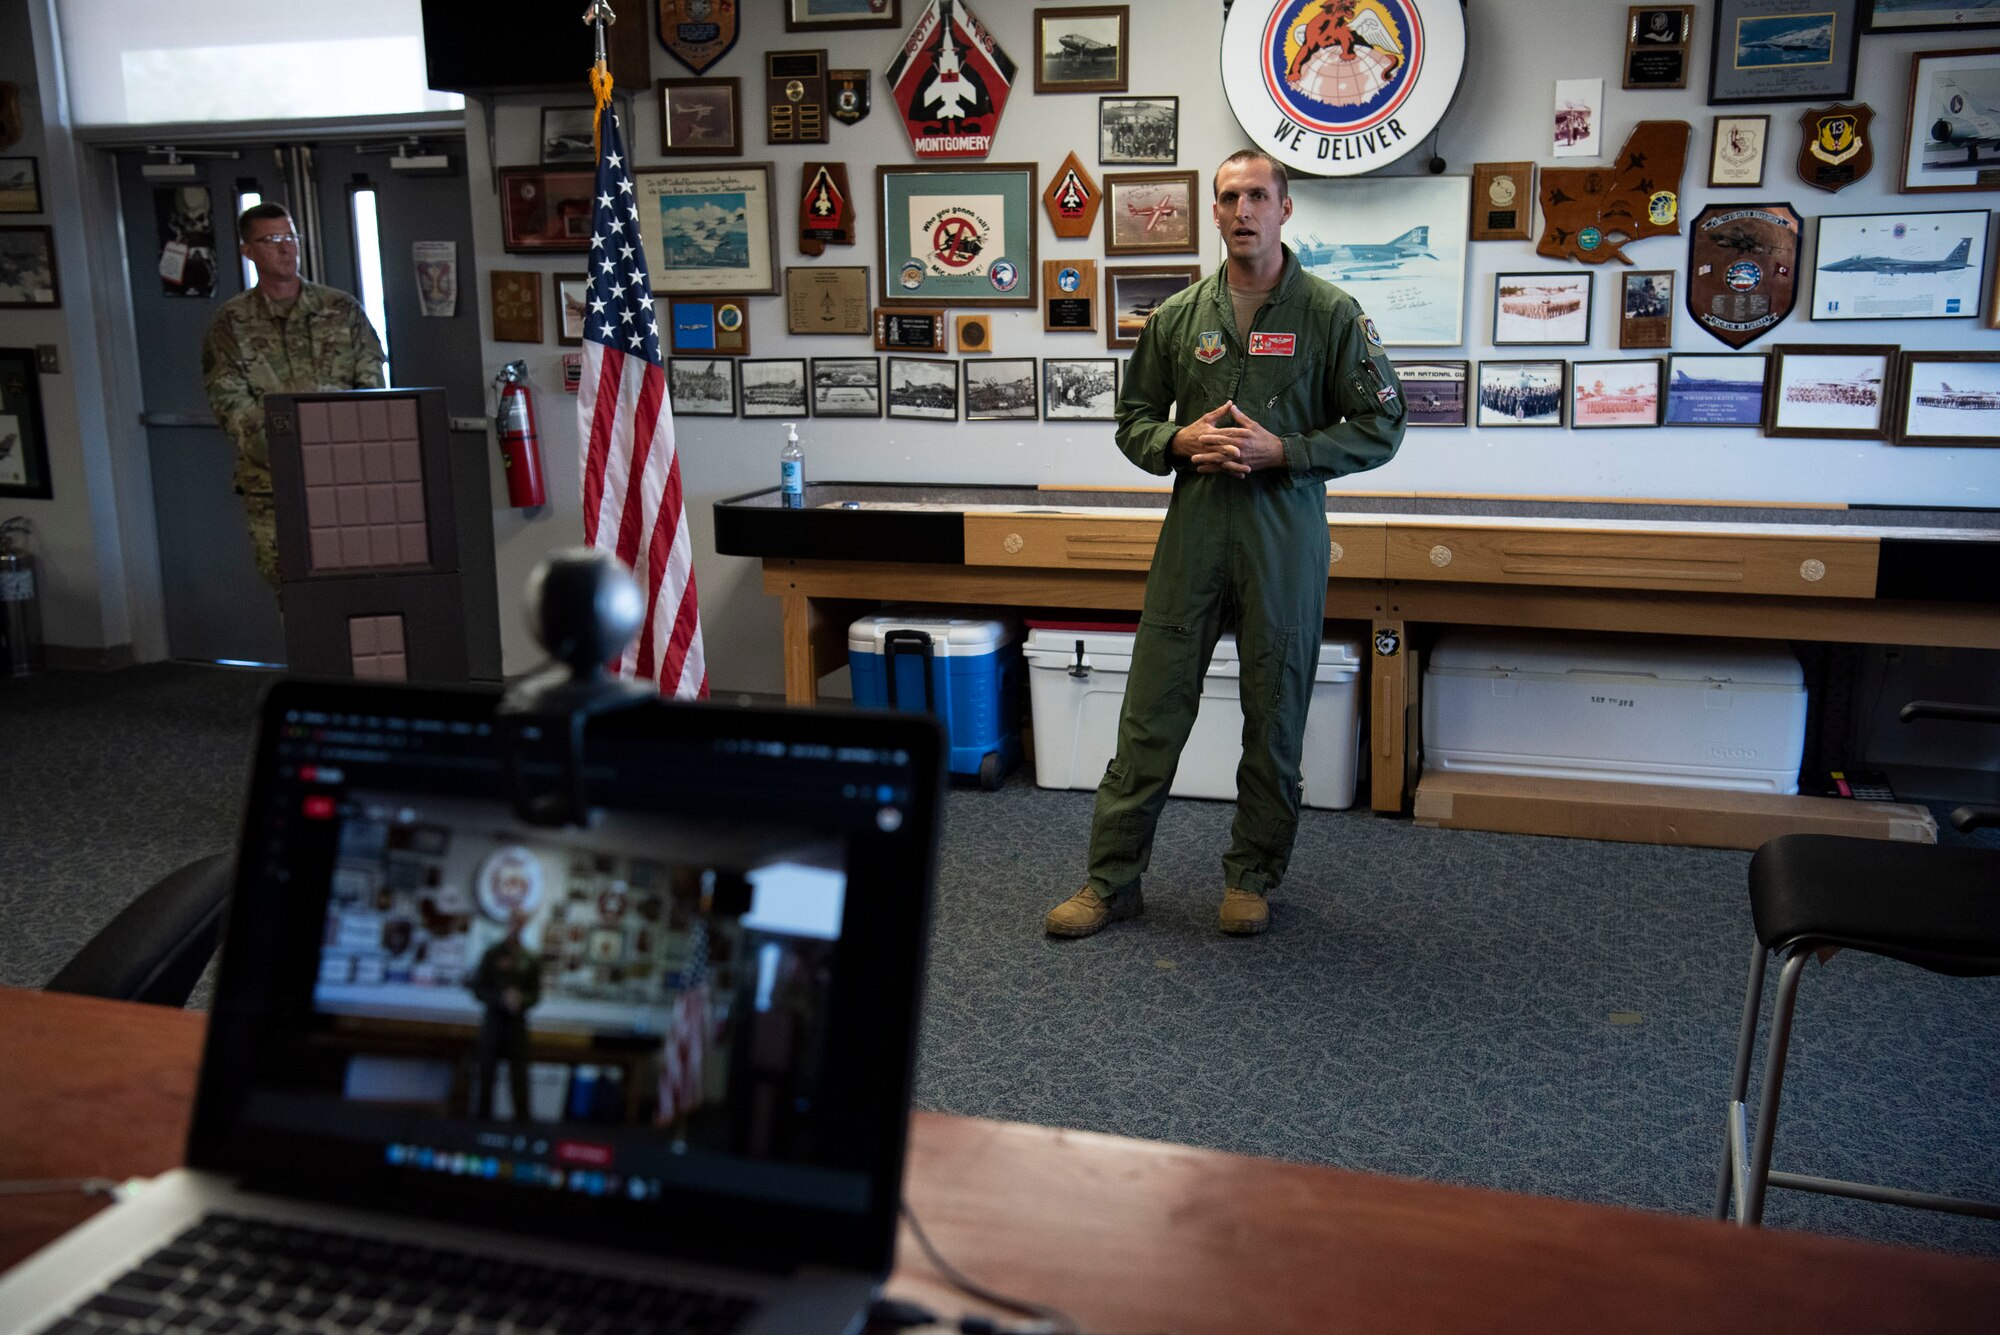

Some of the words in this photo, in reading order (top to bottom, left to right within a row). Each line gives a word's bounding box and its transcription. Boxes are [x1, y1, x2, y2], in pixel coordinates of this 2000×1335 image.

[966, 8, 995, 54] TRS
[1274, 118, 1307, 152] WE
[1317, 119, 1407, 161] DELIVER
[1832, 121, 1844, 135] 13
[915, 136, 990, 152] MONTGOMERY
[922, 216, 937, 233] Who
[936, 207, 950, 219] you
[952, 206, 975, 218] gonna
